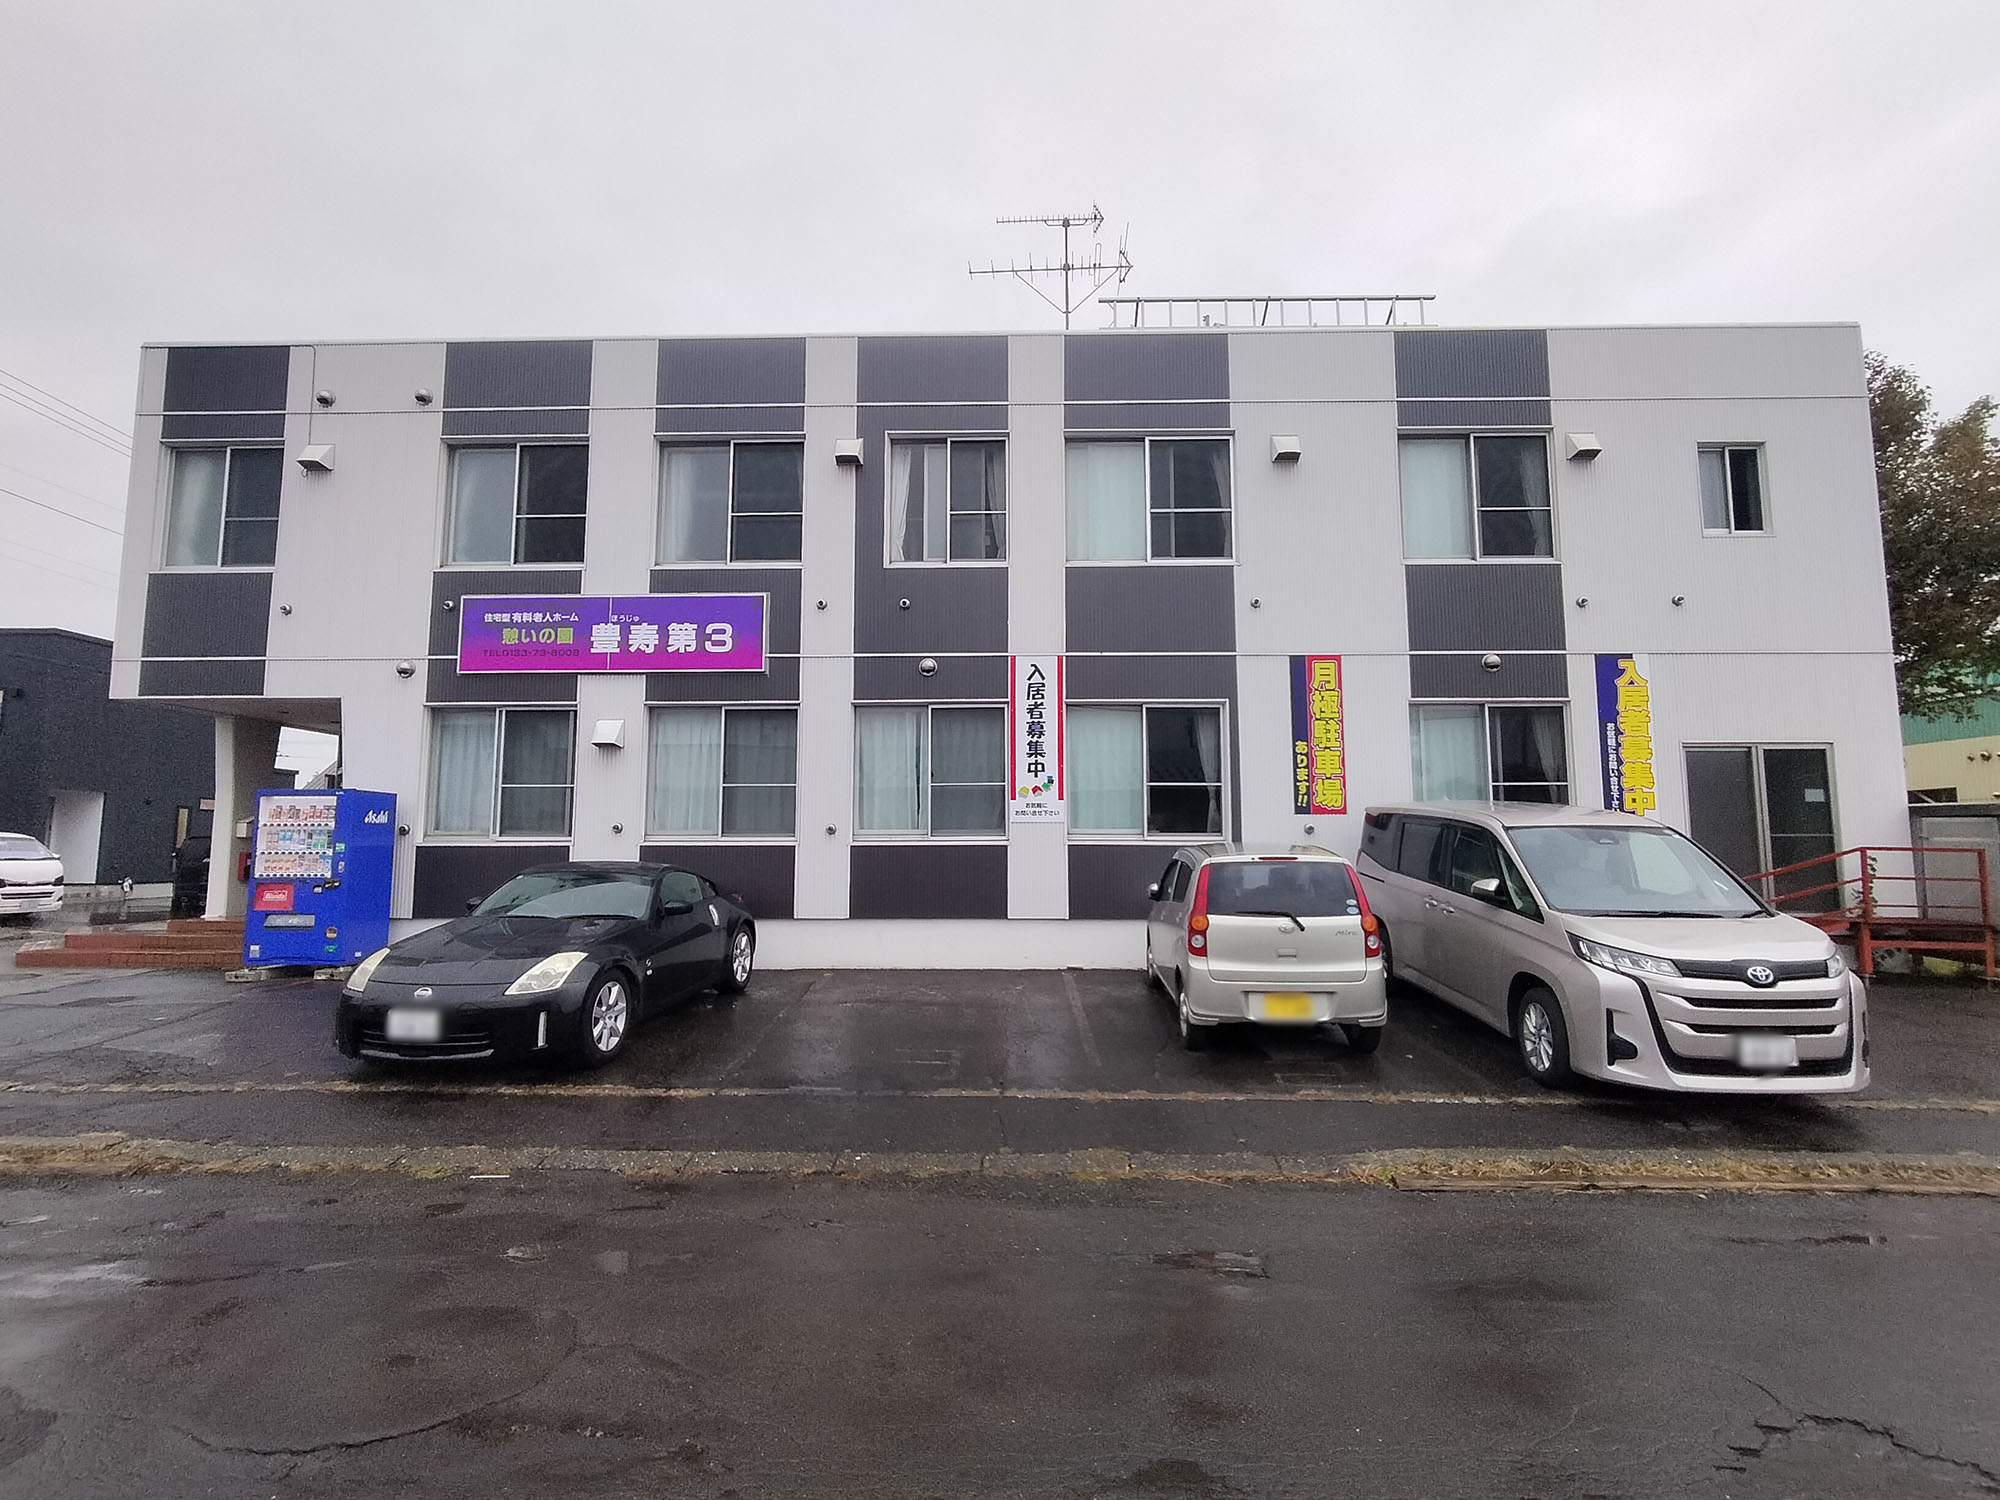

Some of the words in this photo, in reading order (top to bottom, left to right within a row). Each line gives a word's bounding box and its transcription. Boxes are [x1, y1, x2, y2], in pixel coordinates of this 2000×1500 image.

[590, 622, 733, 654] 豊寿第3
[1026, 663, 1047, 779] 入居者募集中
[1311, 660, 1344, 809] 月極駐車場
[1616, 659, 1656, 817] 入居者募集中
